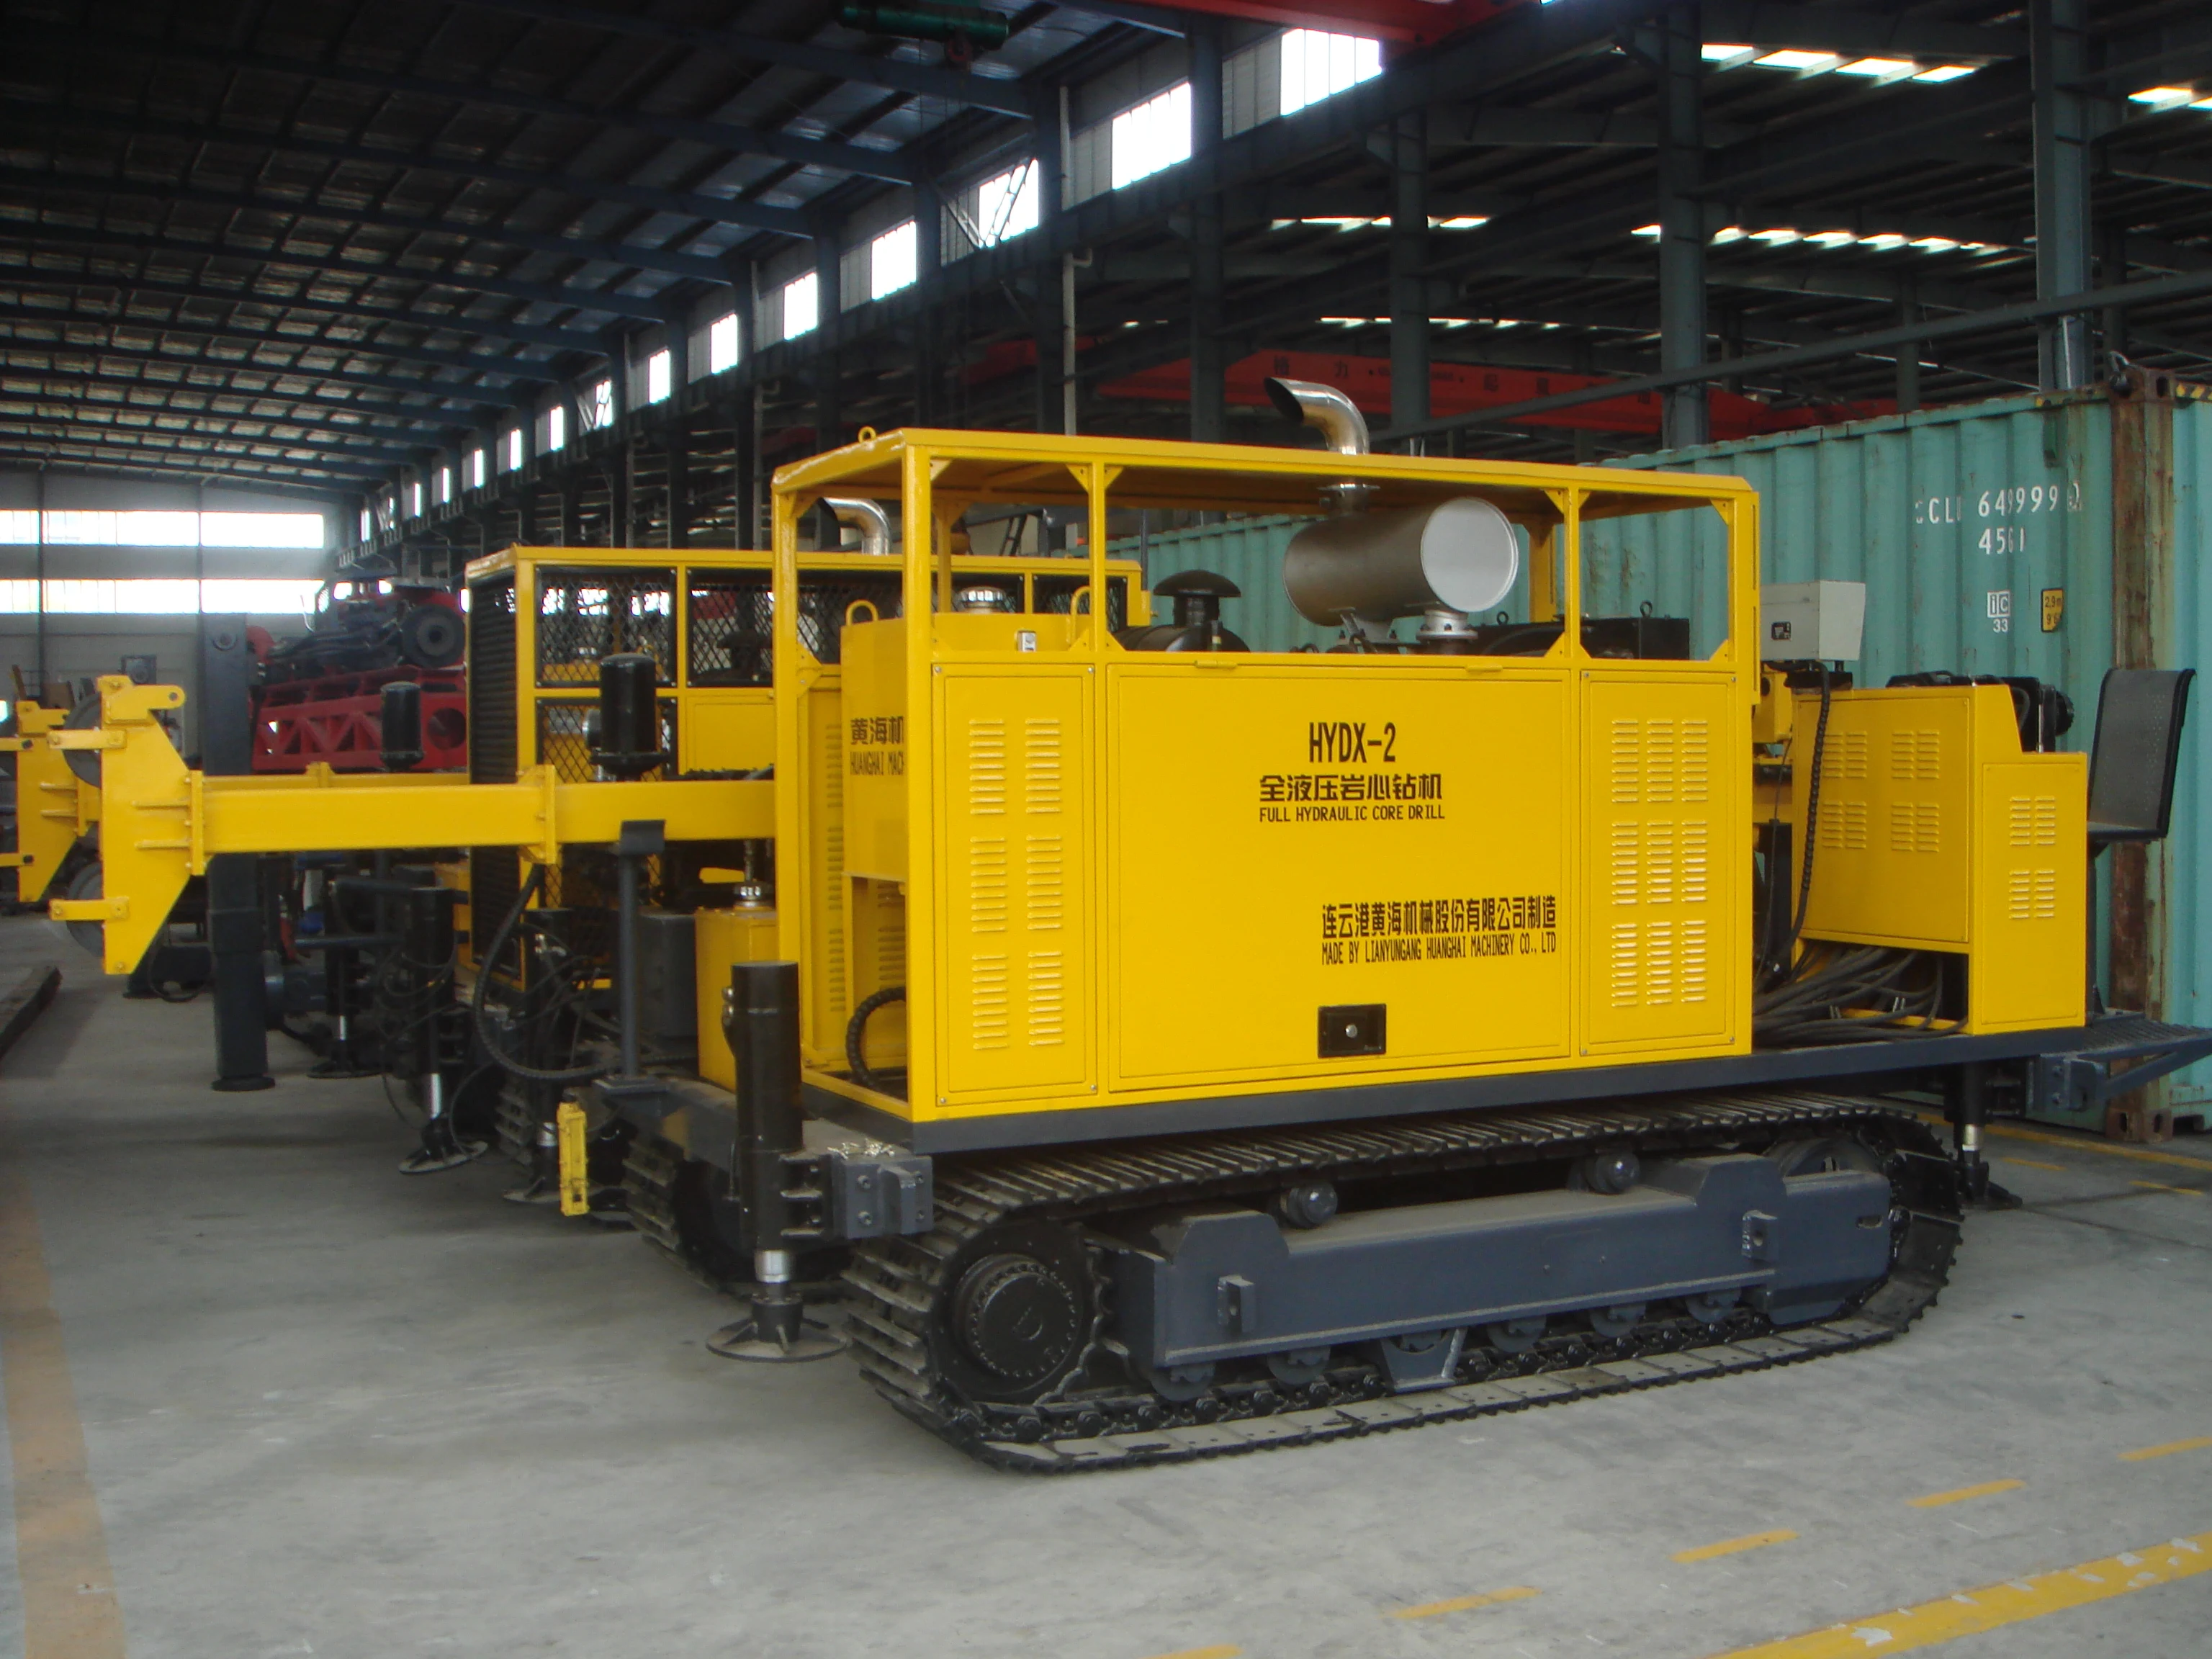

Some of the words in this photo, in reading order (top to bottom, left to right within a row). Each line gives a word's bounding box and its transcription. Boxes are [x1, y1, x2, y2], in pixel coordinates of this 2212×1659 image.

[1978, 485, 2059, 518] 649999
[1992, 618, 2008, 634] 33
[1308, 721, 1396, 763] HYDX-2
[1259, 773, 1442, 801] 全液压岩心钻机
[1259, 806, 1290, 822] FULL
[1296, 805, 1367, 822] HYDRAULIC
[1372, 805, 1403, 820] CORE
[1408, 804, 1444, 819] DRILL
[1321, 894, 1557, 939] 连云港黄海机械股份有限公司制造
[1322, 942, 1344, 965] MADE
[1349, 940, 1359, 963] BY
[1365, 938, 1421, 963] LIANYUNGANG
[1427, 936, 1467, 960] HUANGHAI
[1470, 933, 1514, 957] MACHINERY
[1541, 931, 1557, 953] LTD
